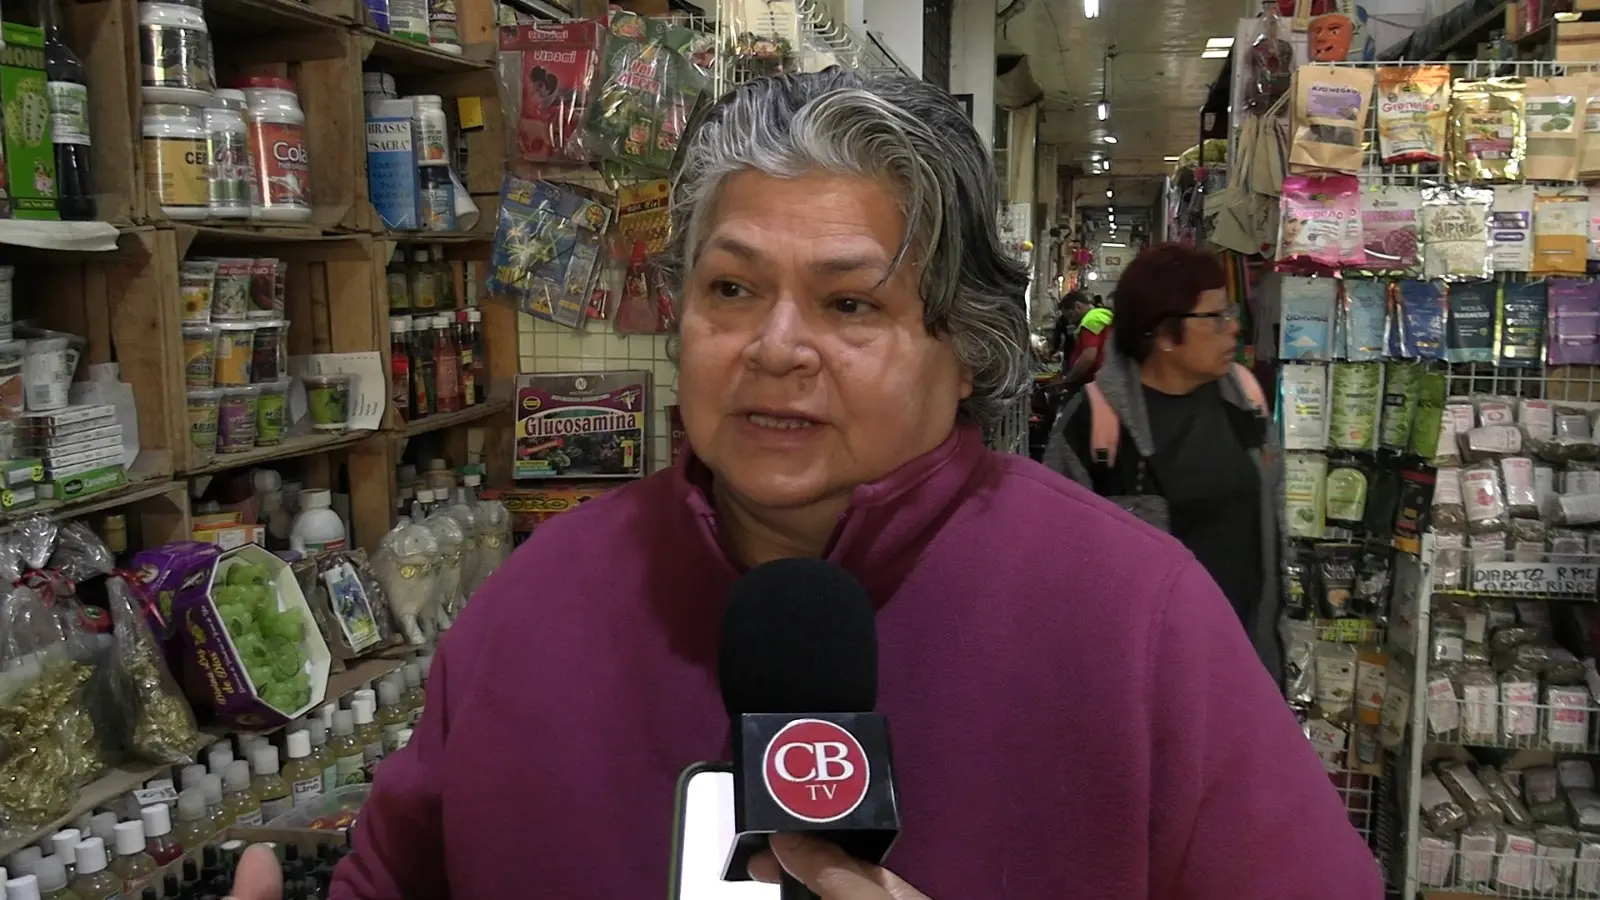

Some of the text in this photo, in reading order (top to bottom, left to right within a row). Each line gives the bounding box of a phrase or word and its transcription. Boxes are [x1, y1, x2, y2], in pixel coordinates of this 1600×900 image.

[368, 123, 407, 134] BRASAS
[524, 411, 637, 438] Glucosamina
[774, 741, 855, 782] CB
[296, 783, 319, 794] Lino
[806, 784, 838, 801] TV
